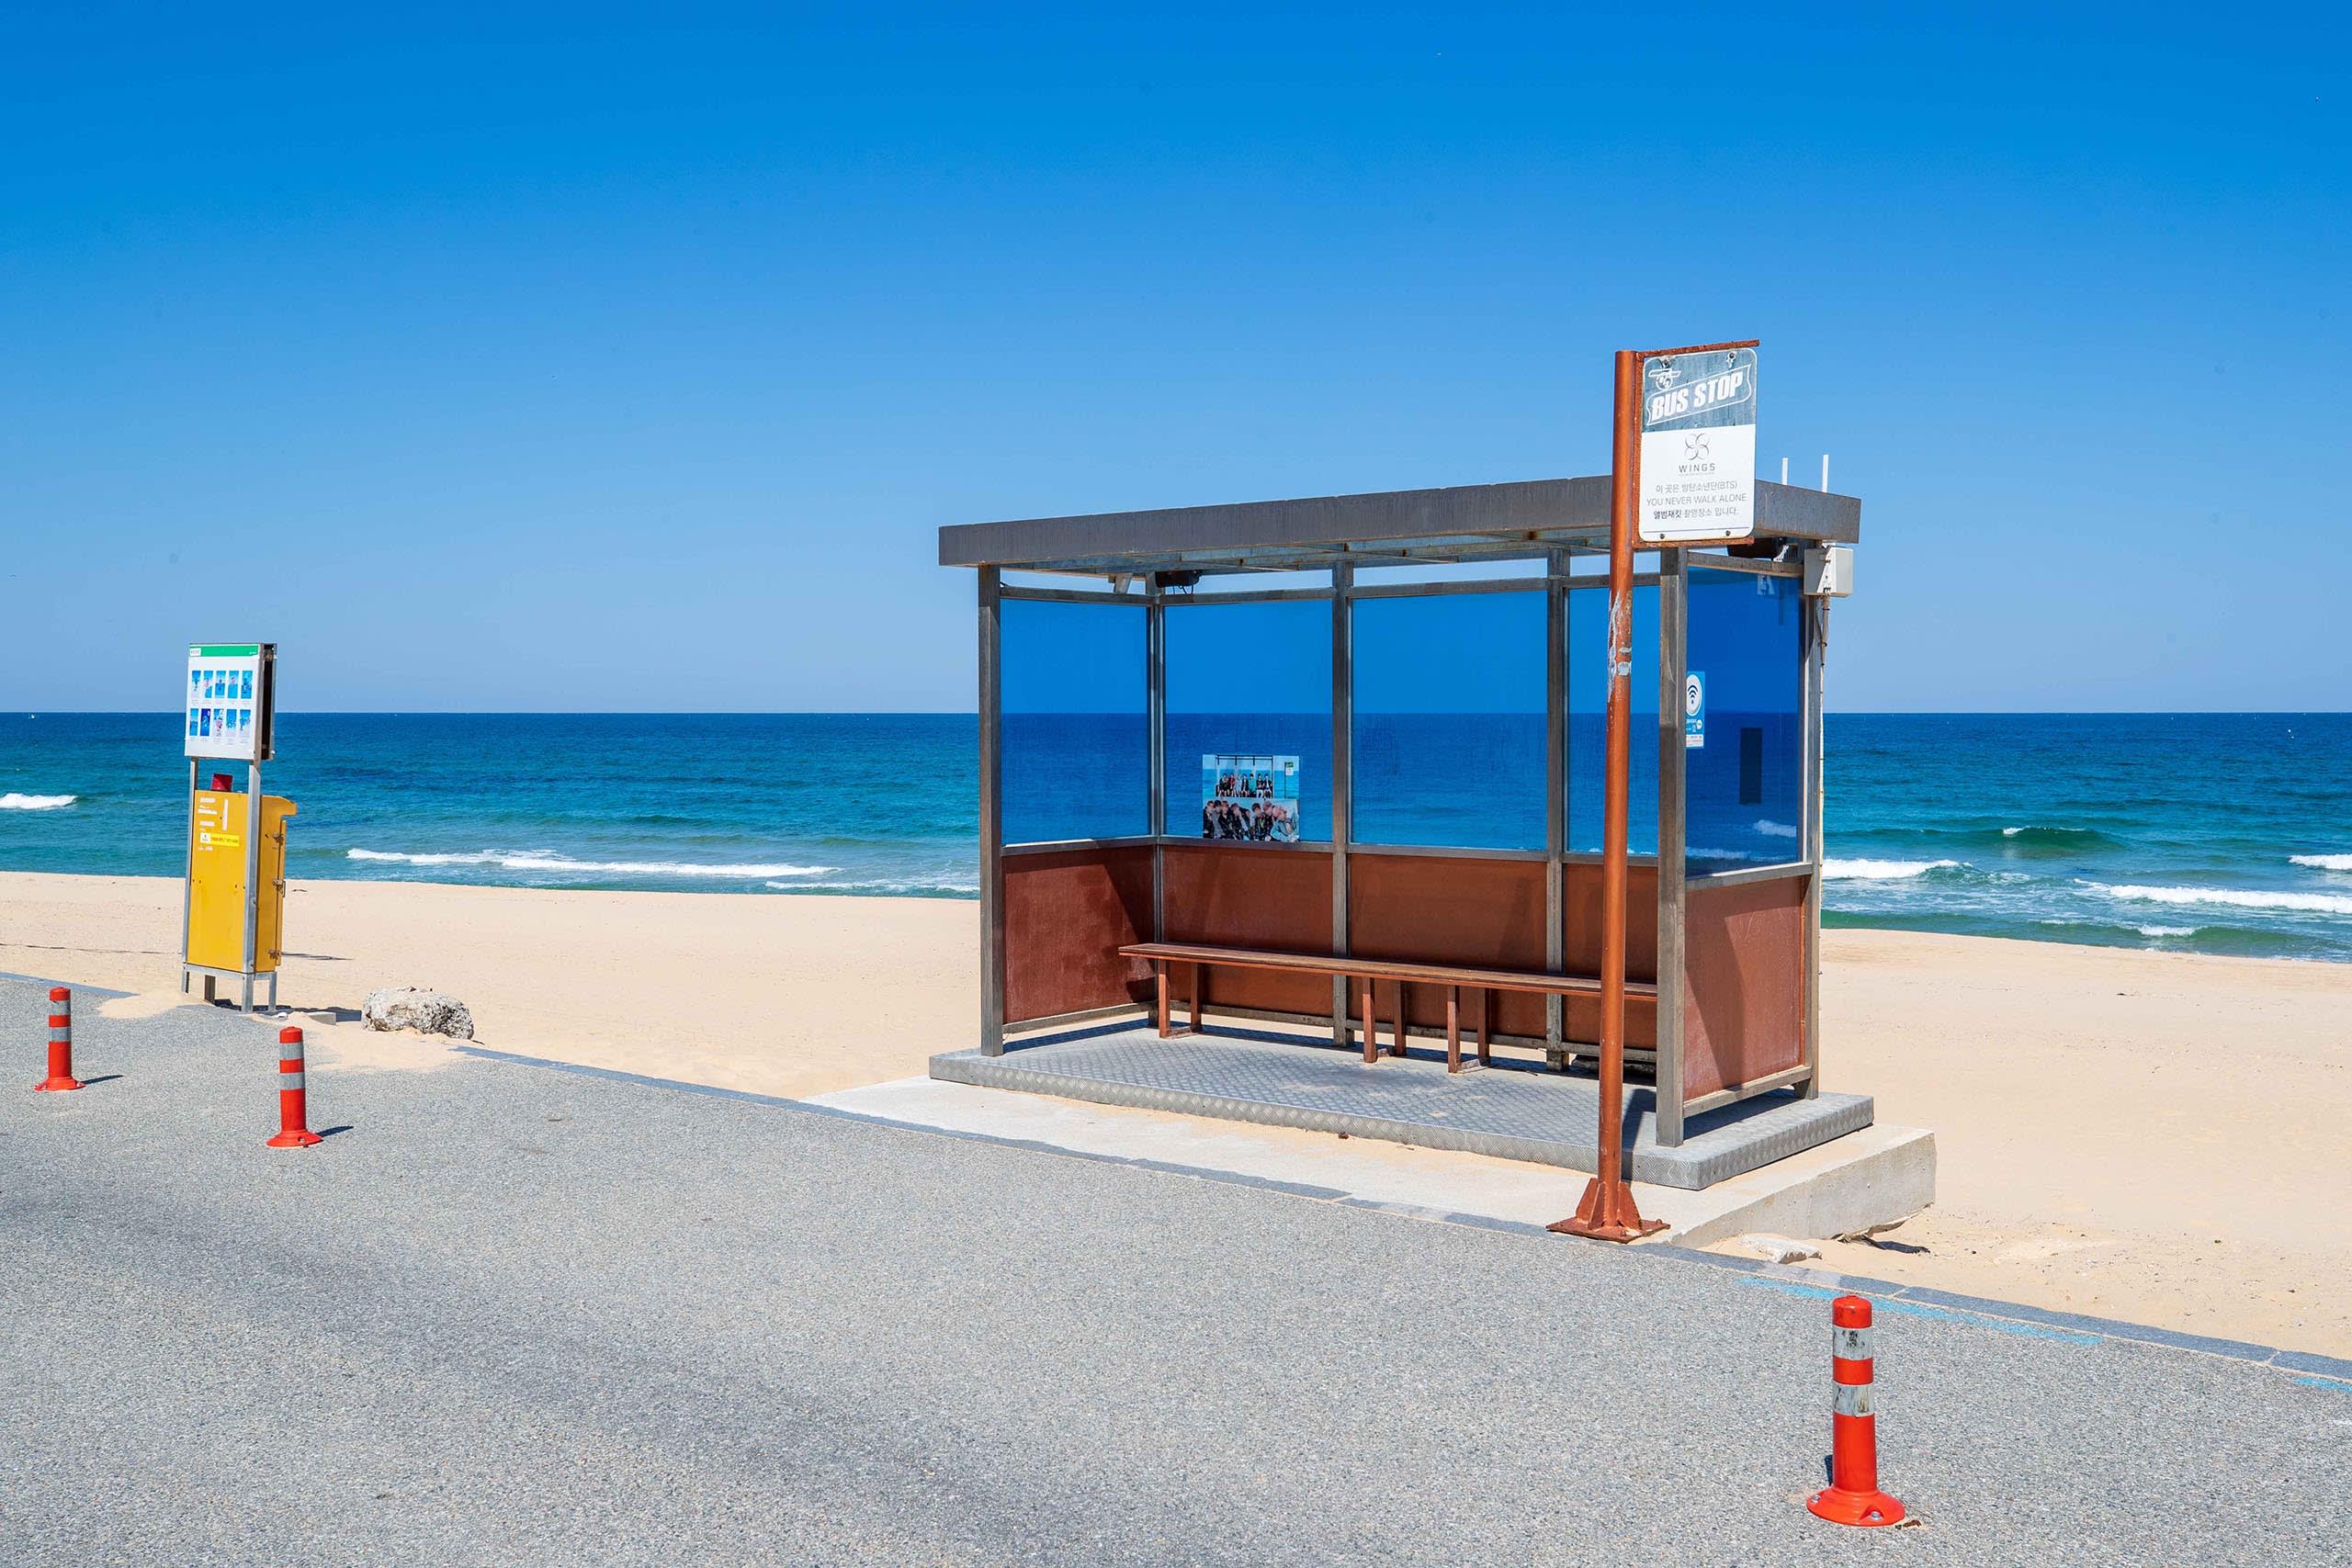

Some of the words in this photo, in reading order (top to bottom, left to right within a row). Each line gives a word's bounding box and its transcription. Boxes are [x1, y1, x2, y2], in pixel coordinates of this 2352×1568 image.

[1651, 388, 1690, 422] BUS
[1693, 371, 1744, 408] STOP
[1678, 462, 1716, 473] WINGS
[1656, 484, 1663, 493] 이
[1665, 483, 1679, 493] 곳은
[1681, 479, 1738, 492] 방탄소년단(BTS)
[1646, 498, 1663, 506] YOU
[1666, 496, 1691, 505] NEVER
[1693, 494, 1717, 504] WALK
[1719, 492, 1747, 502] ALONE
[1714, 506, 1739, 517] 입니다.
